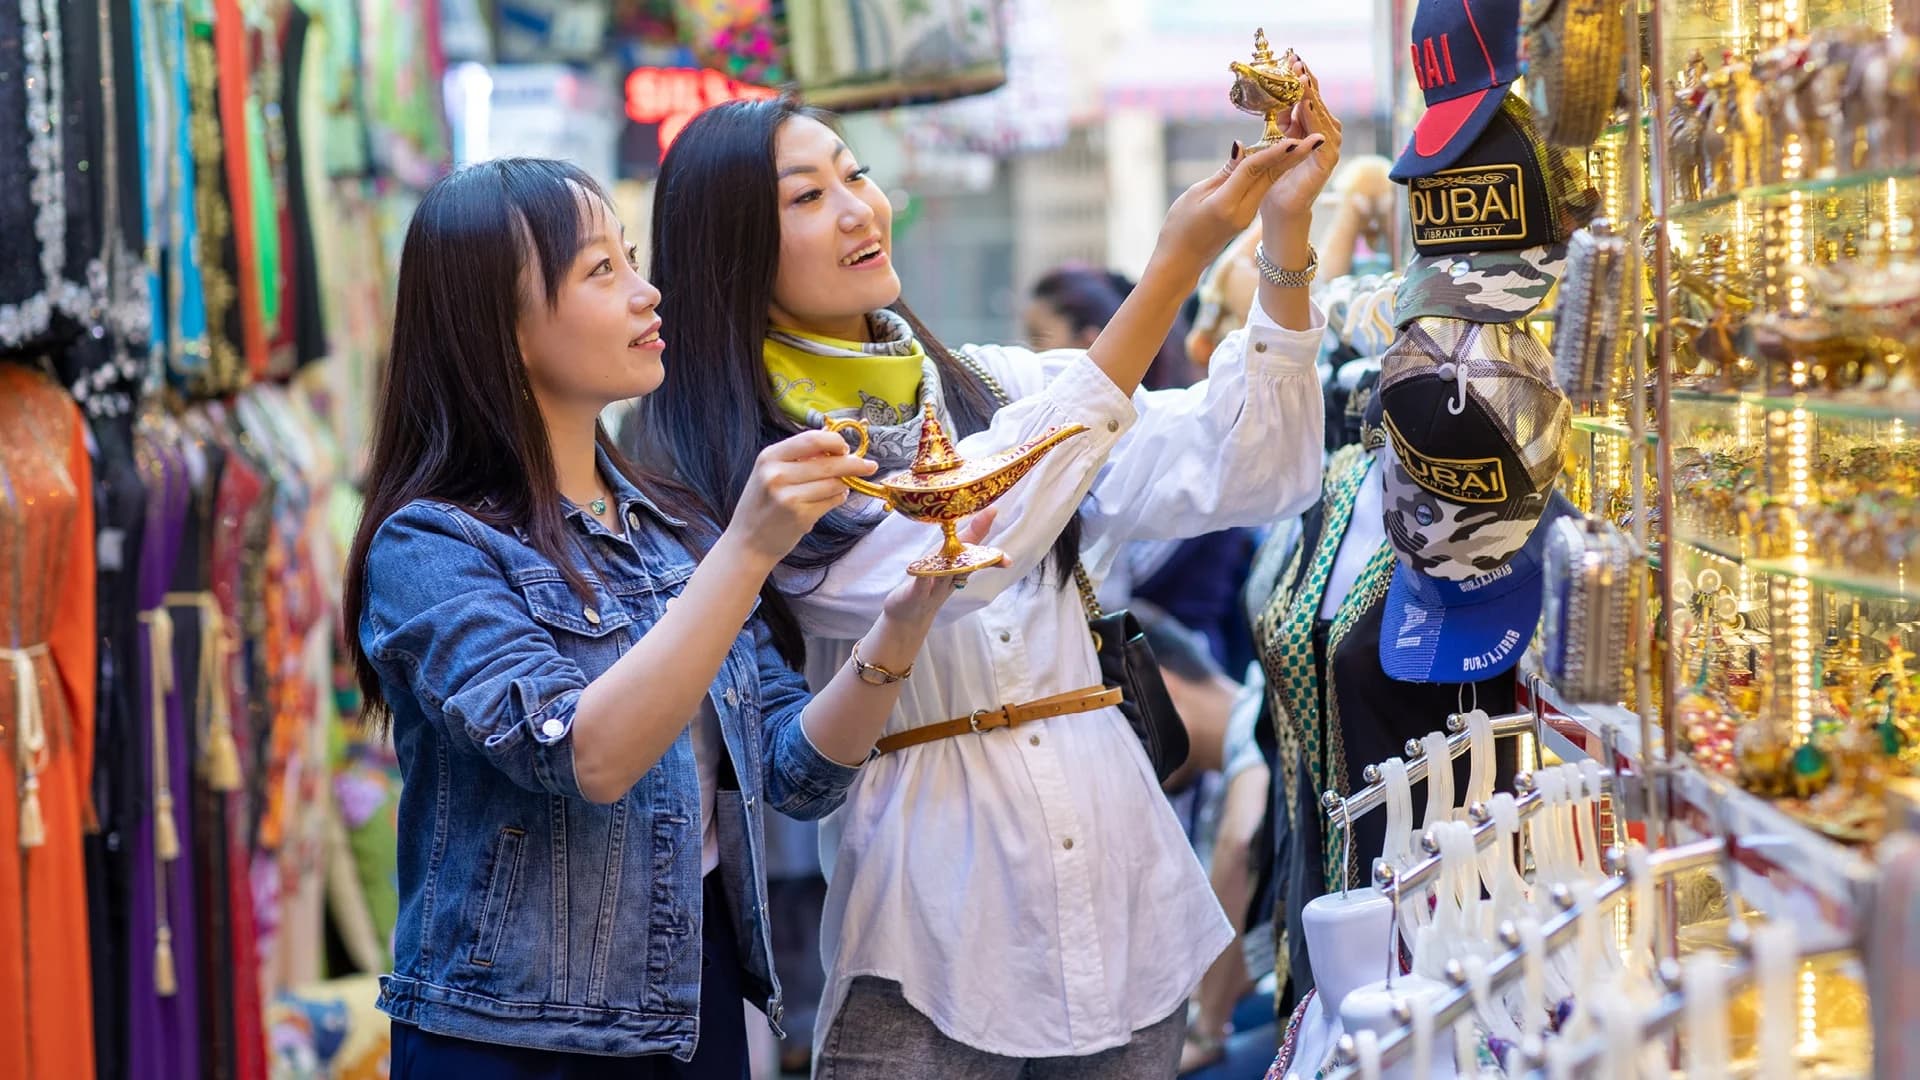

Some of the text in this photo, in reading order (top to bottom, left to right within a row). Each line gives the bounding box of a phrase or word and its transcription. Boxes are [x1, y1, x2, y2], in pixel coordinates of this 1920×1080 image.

[1412, 183, 1519, 226] DUBAI
[1423, 227, 1501, 240] VIBRANT CITY
[1452, 488, 1482, 499] CITY
